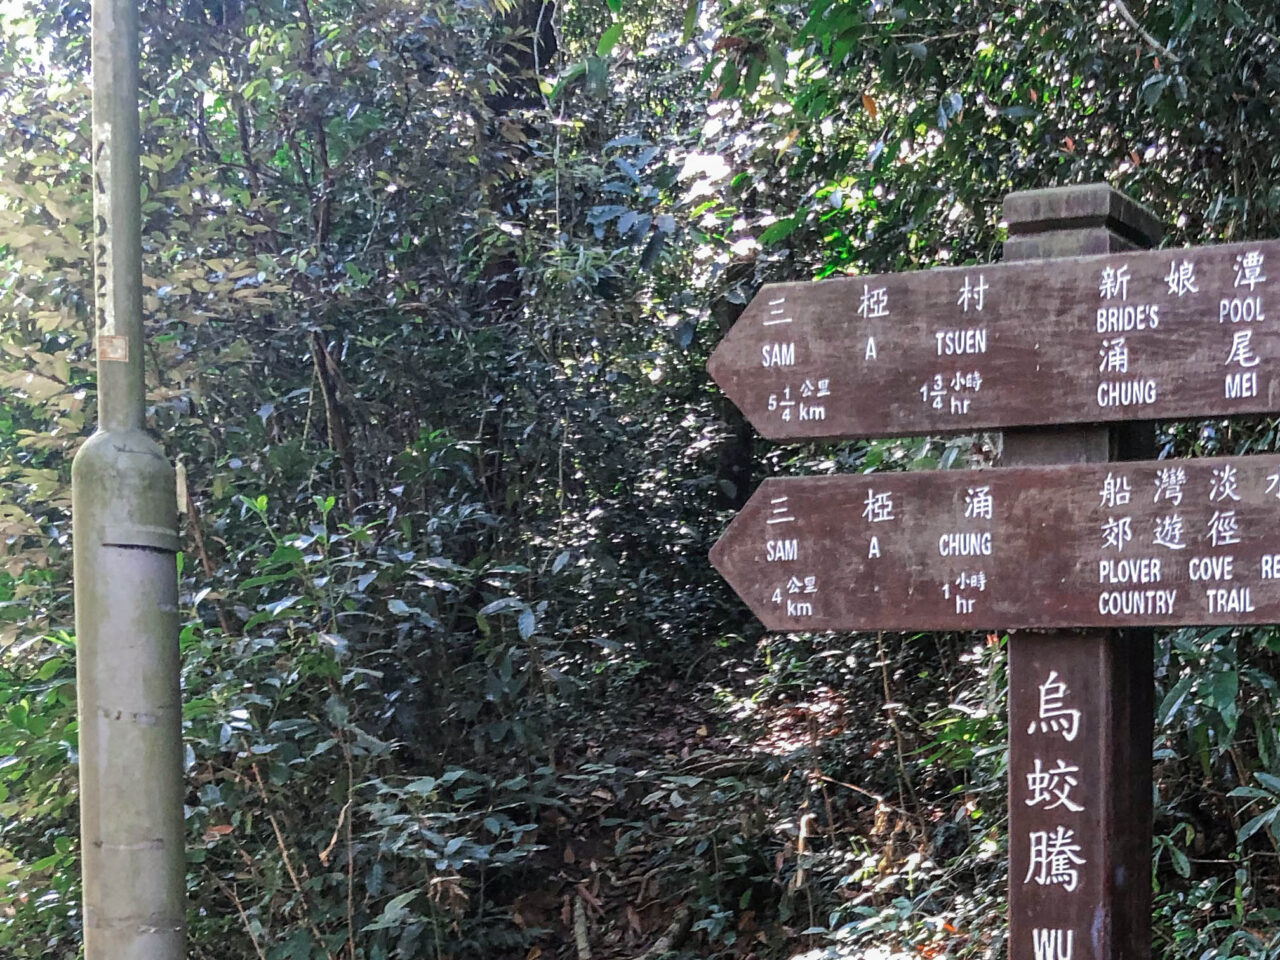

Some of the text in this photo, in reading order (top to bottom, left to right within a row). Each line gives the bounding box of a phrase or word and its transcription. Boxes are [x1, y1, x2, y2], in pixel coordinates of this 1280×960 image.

[1099, 251, 1267, 301] 新娘潭
[1096, 297, 1266, 334] BRIDE'S POOL
[761, 329, 987, 368] SAM A TSUEN
[1099, 330, 1261, 374] 涌尾
[799, 378, 832, 398] 公里
[950, 371, 983, 392] 小時
[1097, 372, 1258, 408] CHUNG MEI
[799, 403, 827, 422] km
[950, 397, 972, 416] hr
[1100, 510, 1242, 553] 郊遊徑
[766, 533, 993, 563] SAM A CHUNG
[1099, 558, 1162, 584] PLOVER
[1189, 555, 1234, 581] COVE
[771, 575, 818, 605] 4 公里
[942, 571, 988, 600] 1 小時
[787, 600, 813, 617] km
[955, 596, 976, 614] hr
[1098, 587, 1255, 615] COUNTRY TRAIL
[1023, 670, 1087, 892] 烏蛟騰
